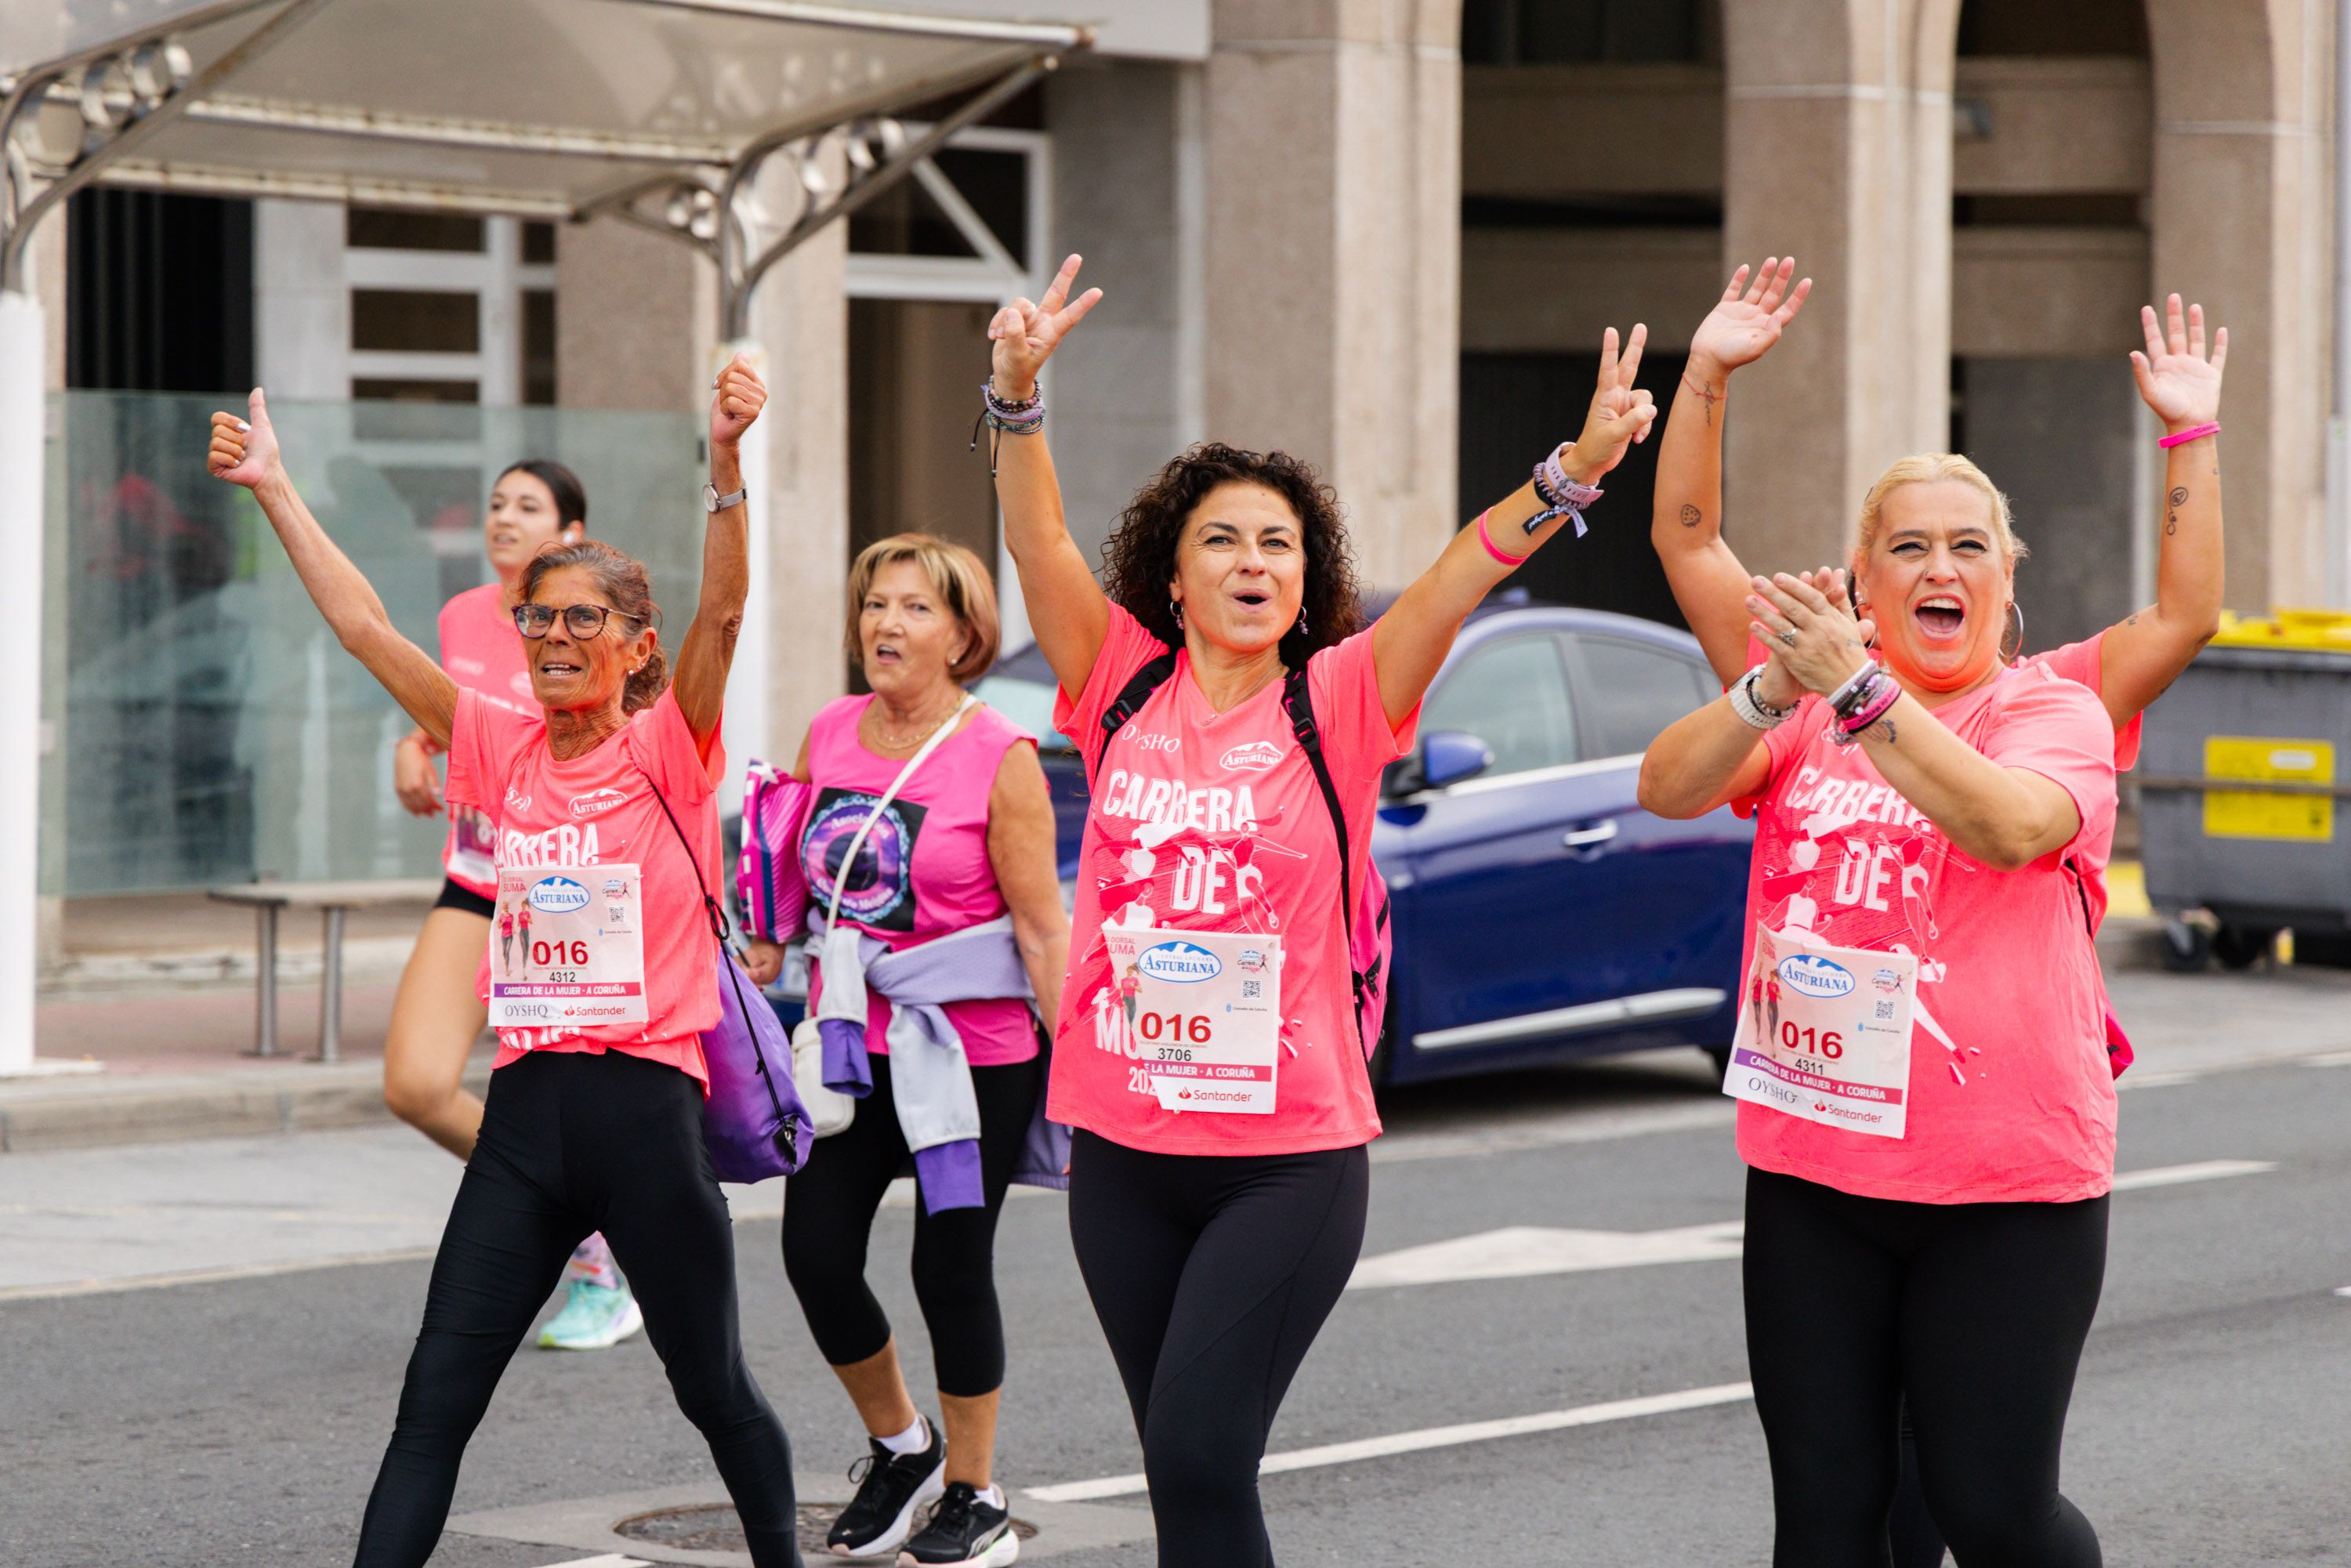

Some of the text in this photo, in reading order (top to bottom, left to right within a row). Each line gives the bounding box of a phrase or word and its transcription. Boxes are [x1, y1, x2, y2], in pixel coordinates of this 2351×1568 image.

[1122, 724, 1180, 753] OYSHO
[1103, 769, 1259, 833] CARRERA
[494, 823, 600, 867] ARRERA
[1170, 843, 1235, 914] DE
[1831, 836, 1902, 912] DE
[503, 882, 527, 893] SUMA
[533, 890, 585, 904] ASTURIANA
[532, 940, 589, 965] 016
[1107, 943, 1136, 955] UMA
[1143, 954, 1215, 974] ASTURIANA
[549, 972, 576, 983] 4312
[1784, 963, 1848, 991] ASTURIANA
[504, 986, 531, 996] CARRERA
[533, 986, 544, 995] DE
[545, 986, 553, 995] LA
[556, 985, 581, 994] MUJER
[586, 985, 592, 994] A
[593, 984, 626, 994] CORUÑA
[505, 1005, 548, 1017] OYSHO
[577, 1006, 626, 1016] Santander
[1140, 1012, 1212, 1043] 016
[1781, 1020, 1842, 1059] 016
[1157, 1048, 1192, 1061] 3706
[1151, 1064, 1164, 1074] LA
[1165, 1065, 1197, 1076] MUJER
[1206, 1067, 1213, 1077] A
[1215, 1066, 1255, 1078] CORUÑA
[1795, 1058, 1824, 1076] 4311
[1749, 1055, 1779, 1076] CARRERA
[1780, 1067, 1790, 1080] DE
[1790, 1071, 1802, 1084] LA
[1802, 1076, 1831, 1091] MUJER
[1838, 1085, 1845, 1094] A
[1846, 1084, 1886, 1100] CORUÑA
[1194, 1089, 1252, 1102] Santander
[1828, 1104, 1883, 1124] Santander
